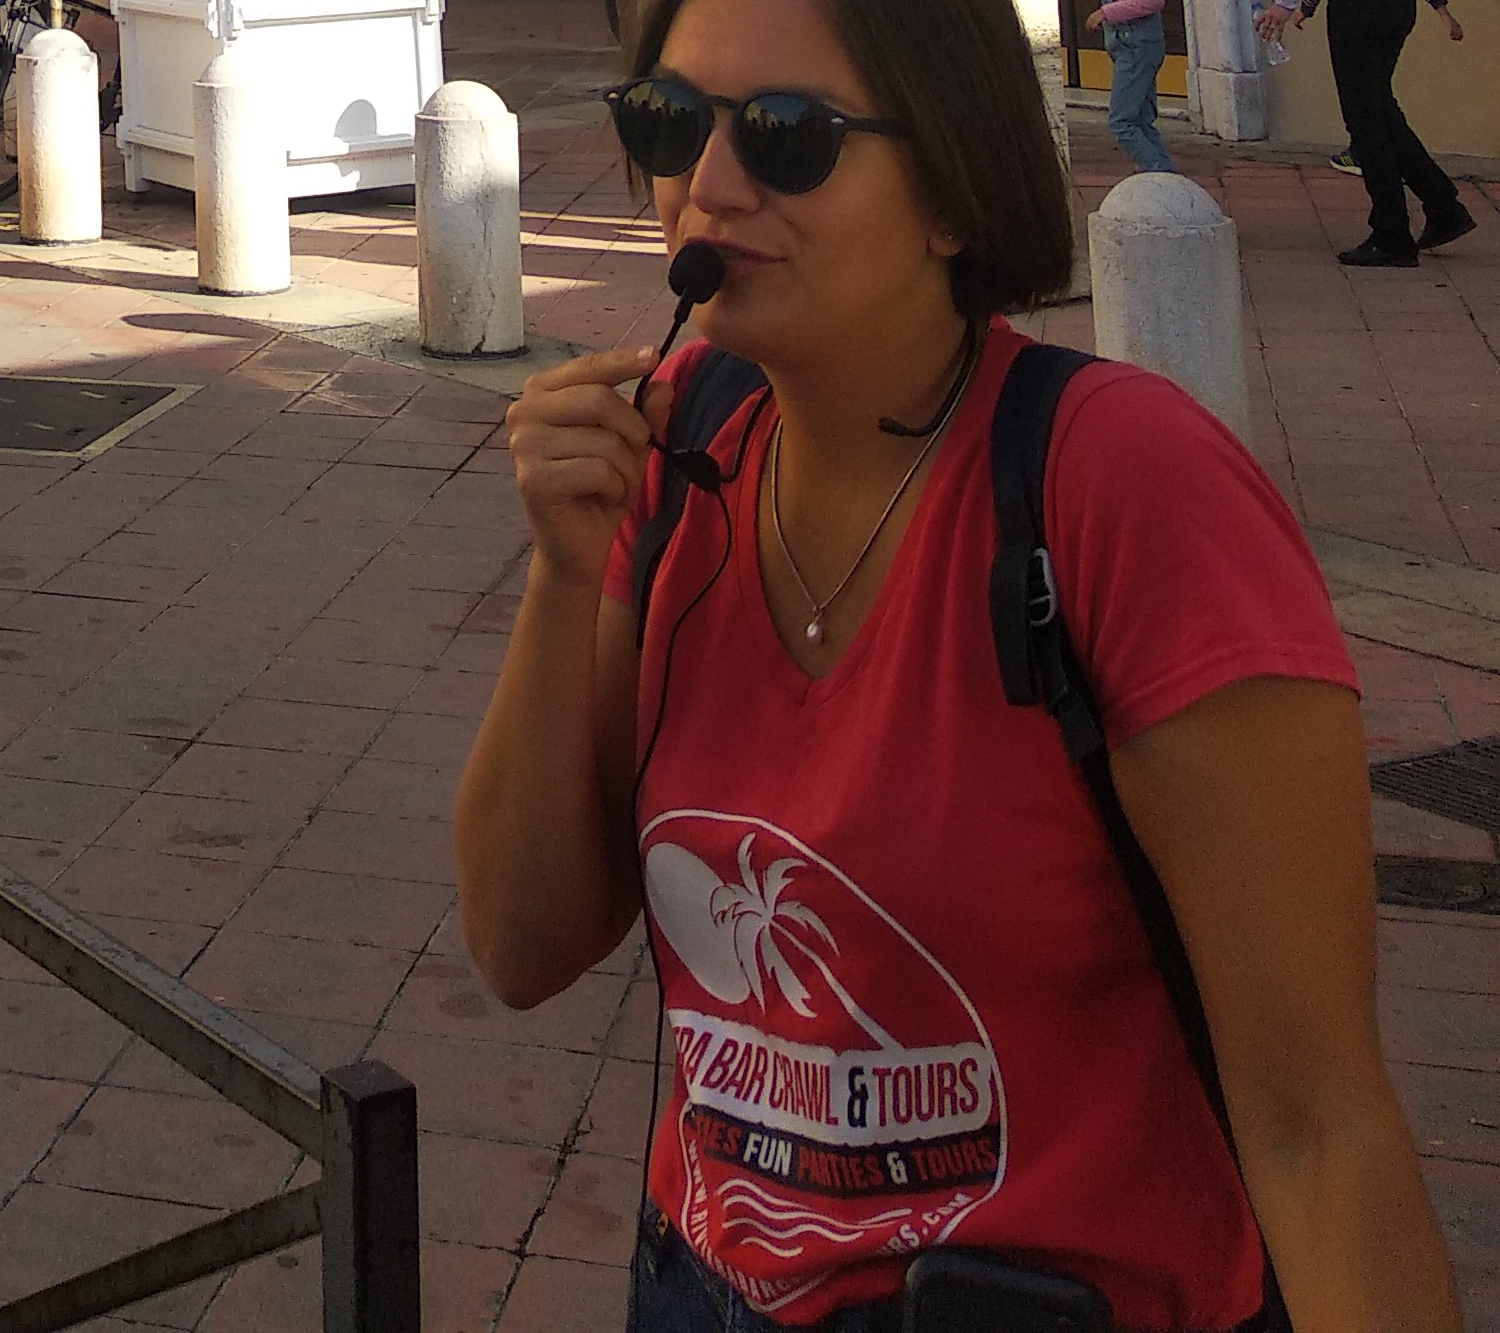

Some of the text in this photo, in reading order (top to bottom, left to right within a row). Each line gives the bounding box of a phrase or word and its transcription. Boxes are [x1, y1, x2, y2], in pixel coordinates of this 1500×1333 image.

[701, 1038, 769, 1105] BAR
[769, 1050, 839, 1126] CRAWL
[848, 1066, 869, 1128] &
[872, 1058, 979, 1127] TOURS
[743, 1133, 793, 1177] FUN
[886, 1151, 908, 1185] &
[911, 1138, 998, 1182] TOURS
